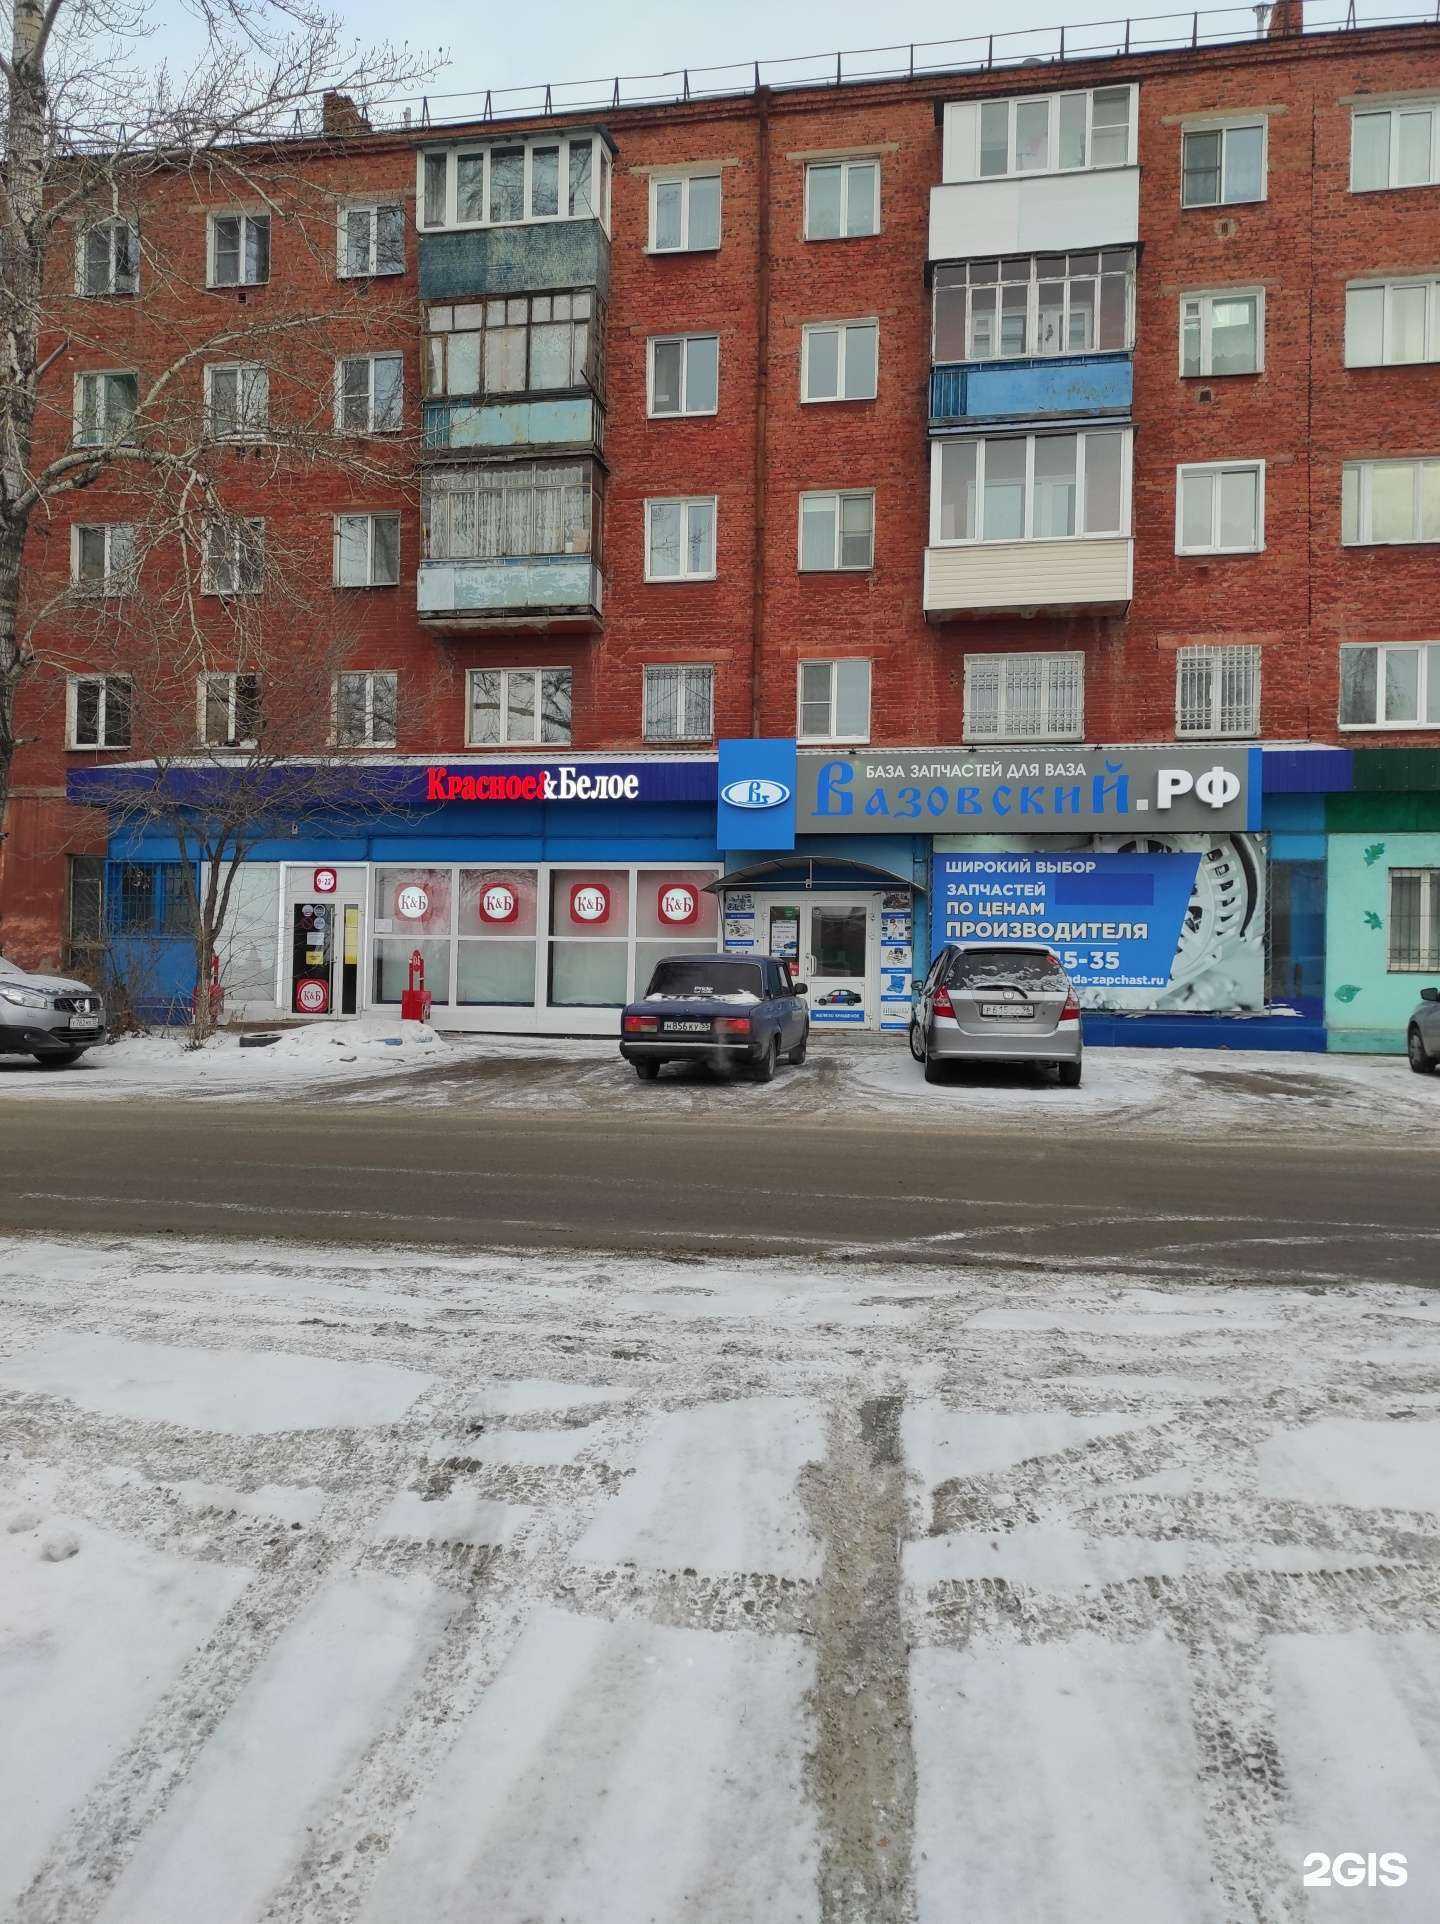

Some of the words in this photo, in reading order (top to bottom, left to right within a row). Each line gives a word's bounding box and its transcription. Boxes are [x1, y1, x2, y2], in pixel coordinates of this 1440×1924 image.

[865, 764, 906, 779] БАЗА
[909, 760, 1002, 779] ЗАПЧАСТЕЙ
[1006, 763, 1040, 779] ДЛЯ
[1045, 762, 1087, 777] ВАЗА
[945, 858, 1031, 874] ШИРОКИЙ
[1035, 861, 1097, 874] ВЫБОР
[946, 881, 1046, 896] ЗАПЧАСТЕЙ
[400, 894, 427, 910] К&Б
[486, 895, 512, 911] К&Б
[577, 896, 604, 912] К&Б
[665, 896, 692, 913] К&Б
[946, 901, 974, 915] ПО
[978, 902, 1045, 917] ЦЕНАМ
[946, 921, 1149, 942] ПРОИЗВОДИТЕЛЯ
[303, 990, 321, 1001] К&Б
